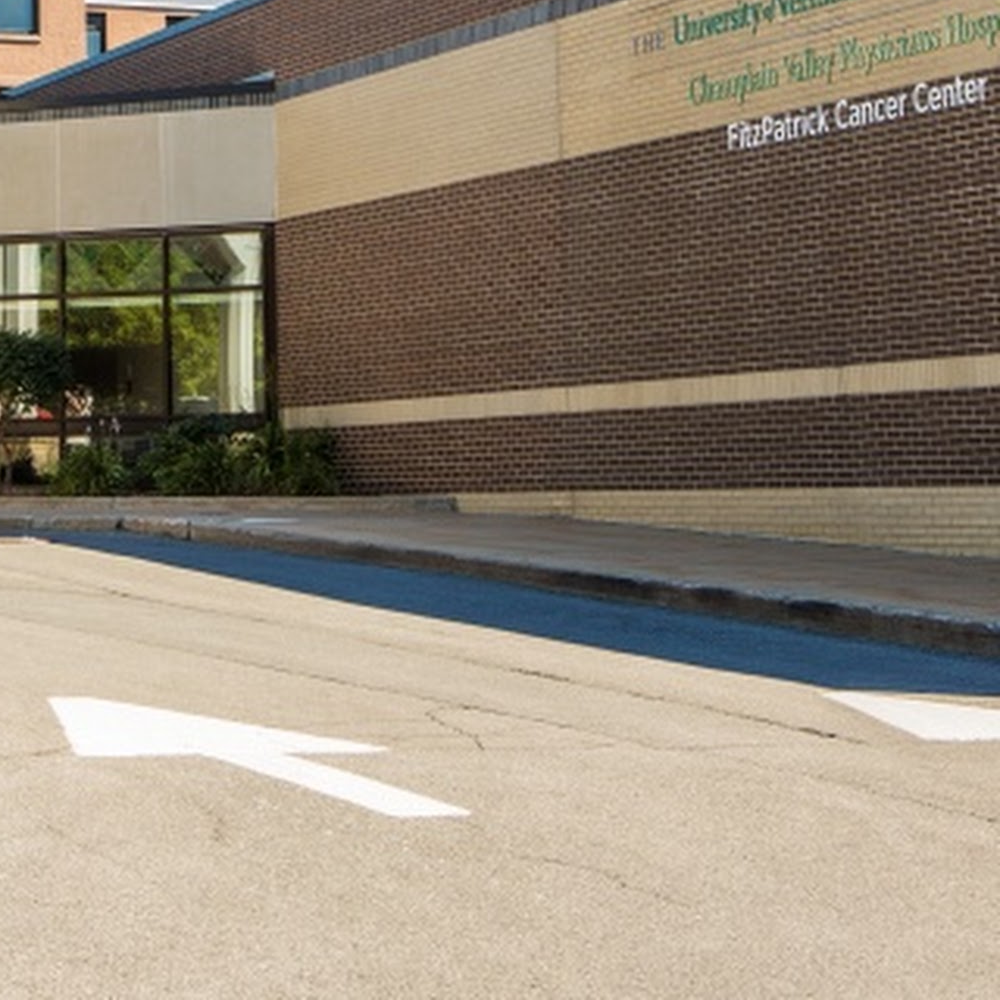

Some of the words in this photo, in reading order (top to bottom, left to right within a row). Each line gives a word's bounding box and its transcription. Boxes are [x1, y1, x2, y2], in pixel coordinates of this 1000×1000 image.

[632, 31, 664, 55] THE
[673, 1, 760, 46] University
[727, 105, 830, 150] FitzPatrick
[834, 92, 907, 130] Cancer
[912, 75, 988, 114] Center
